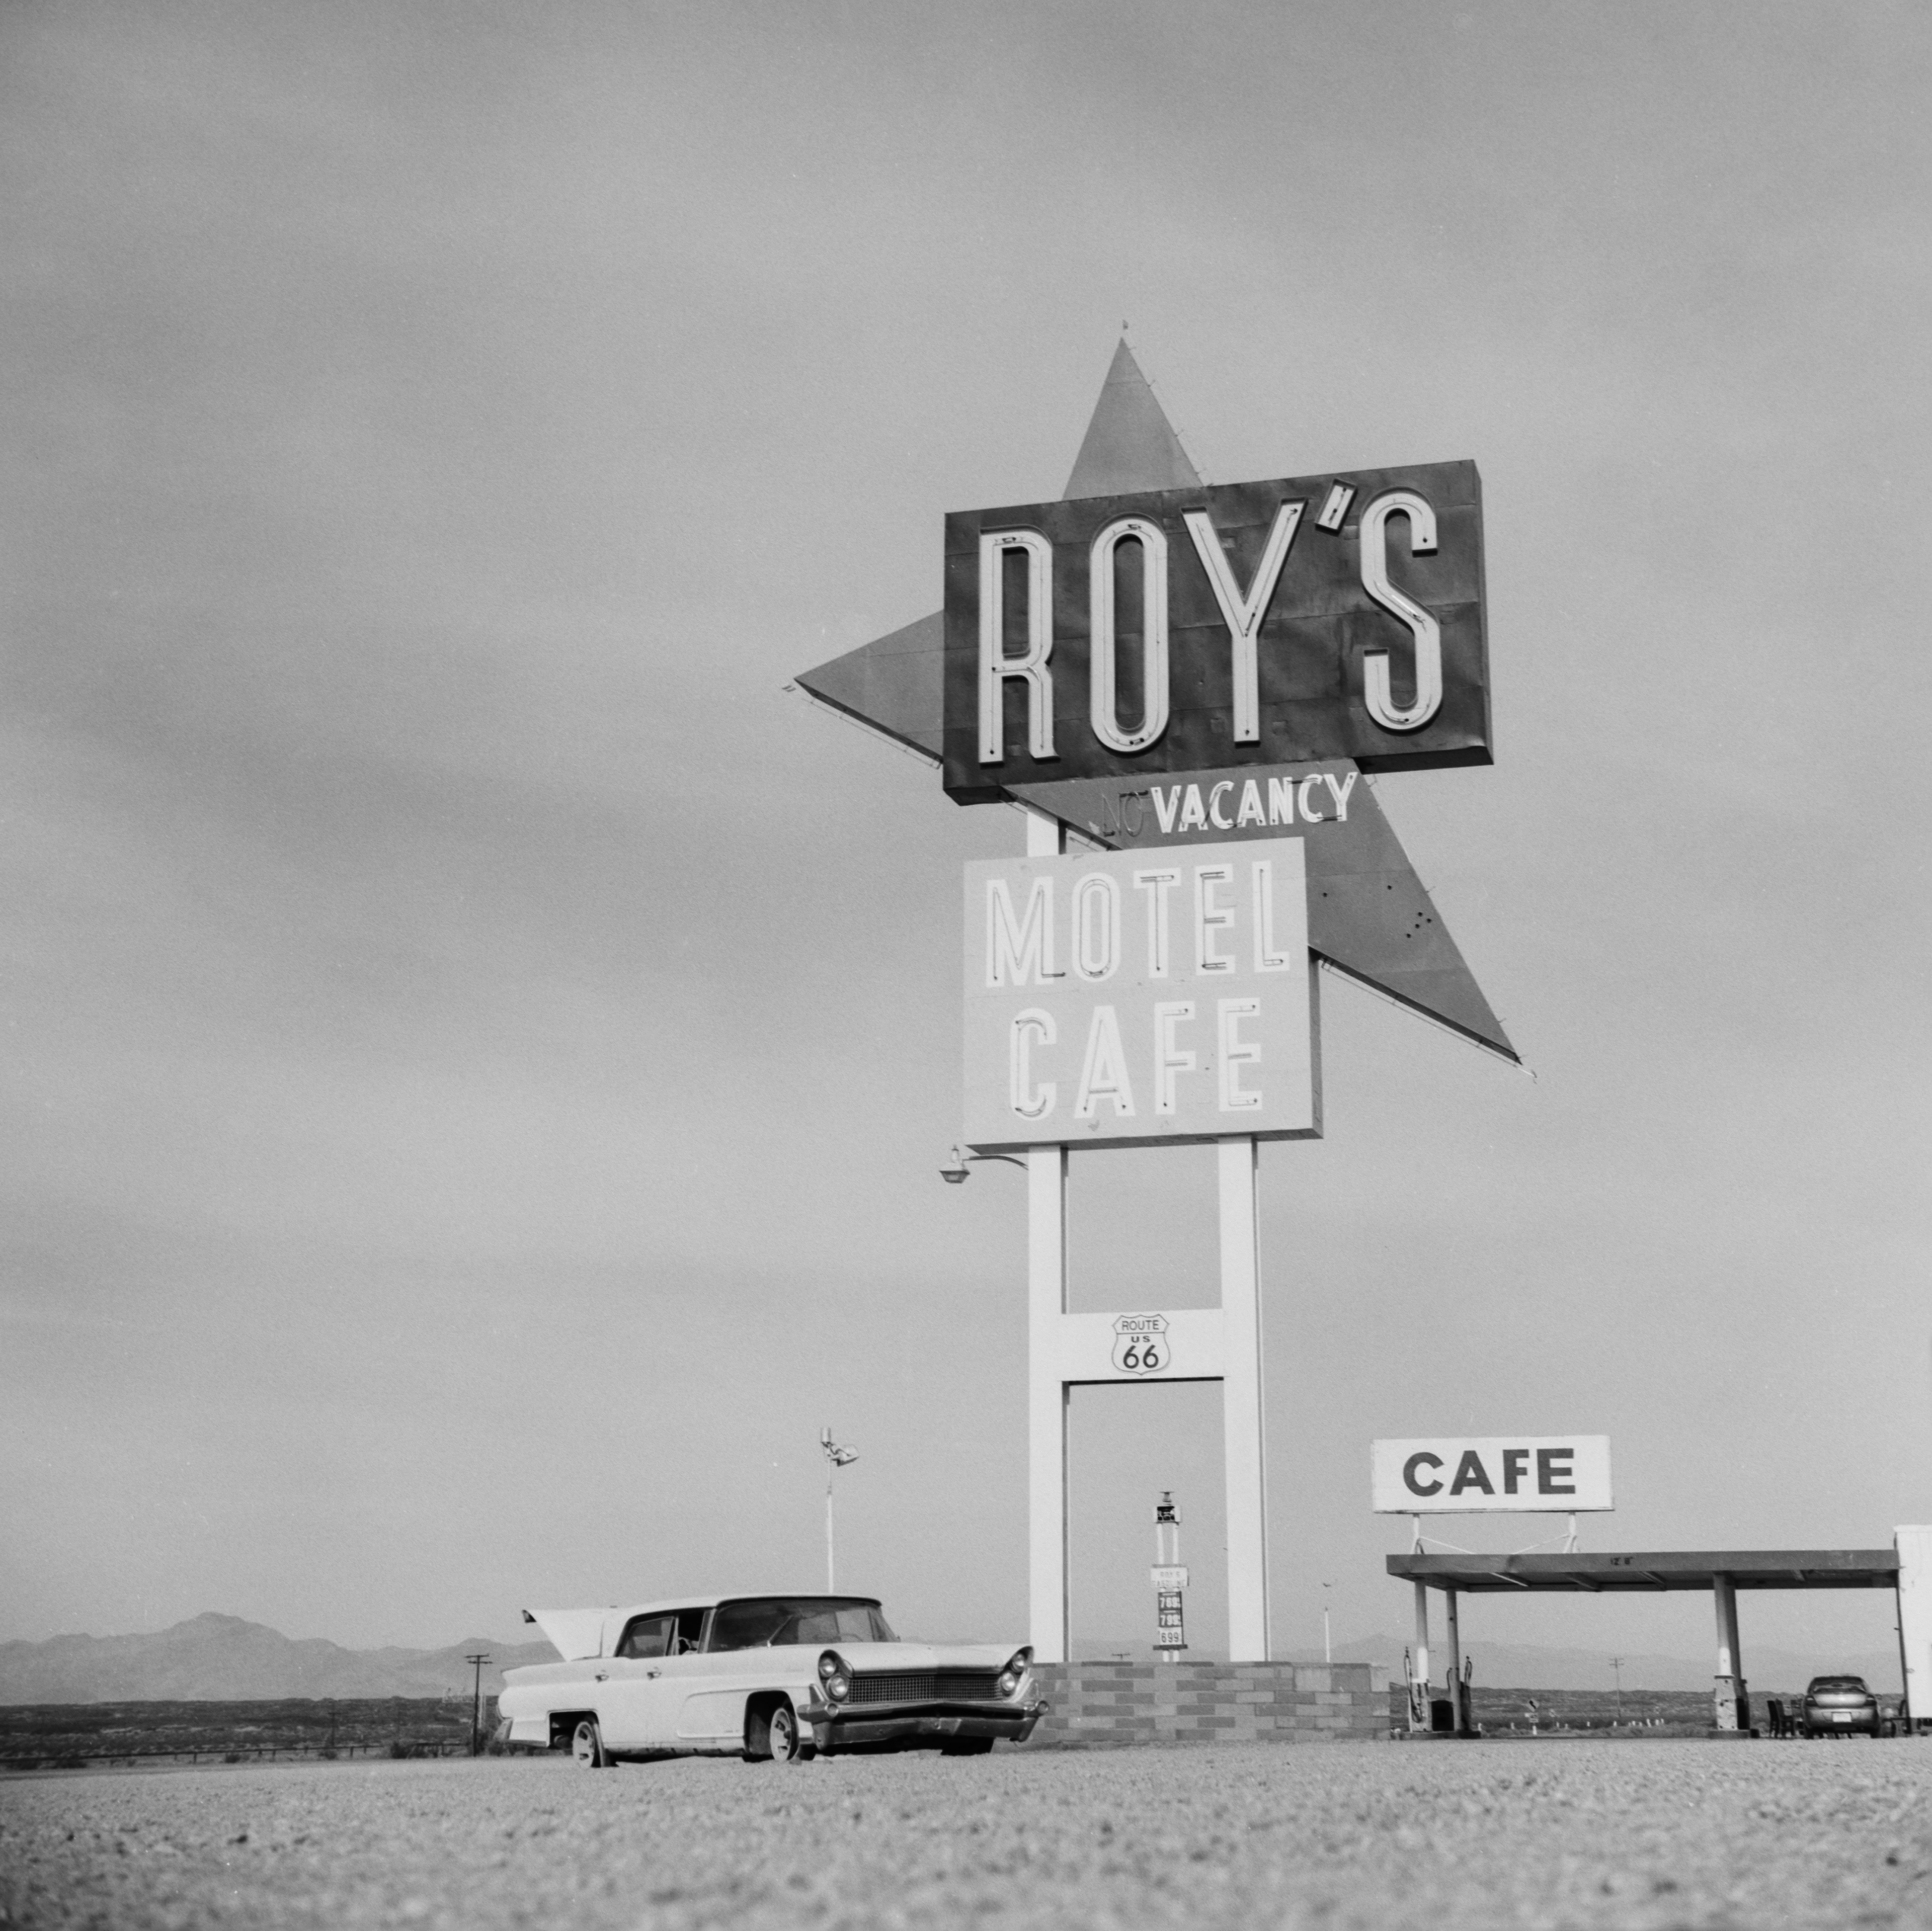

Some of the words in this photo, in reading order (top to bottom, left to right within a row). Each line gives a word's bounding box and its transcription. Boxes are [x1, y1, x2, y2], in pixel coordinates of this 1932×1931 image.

[979, 478, 1443, 764] ROY'S
[1151, 772, 1358, 833] VACANCY
[986, 860, 1290, 987] MOTEL
[1009, 998, 1263, 1121] CAFE
[1122, 1320, 1160, 1331] ROUTE
[1123, 1344, 1159, 1369] 66
[1403, 1448, 1575, 1496] CAFE
